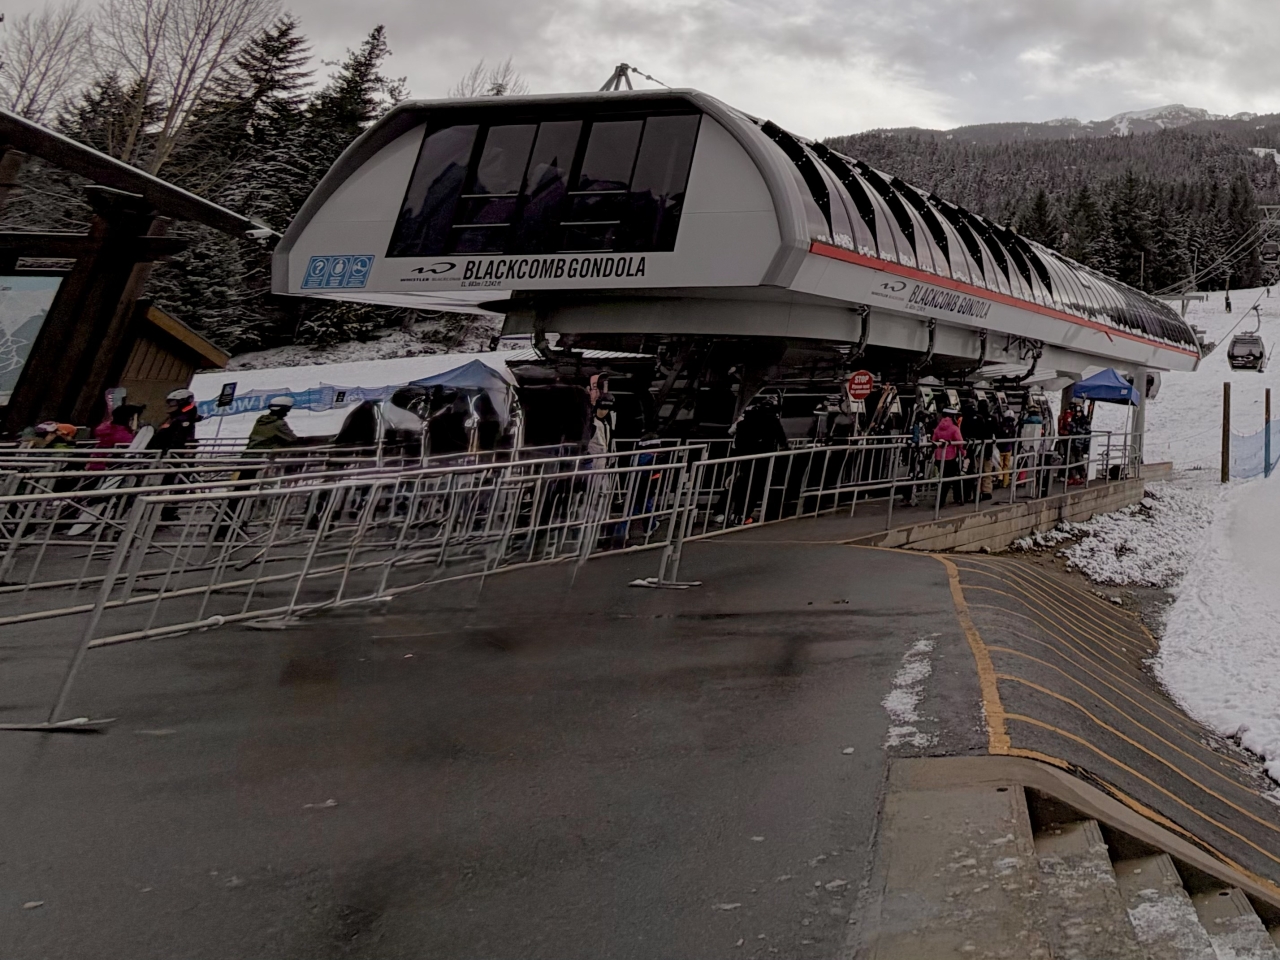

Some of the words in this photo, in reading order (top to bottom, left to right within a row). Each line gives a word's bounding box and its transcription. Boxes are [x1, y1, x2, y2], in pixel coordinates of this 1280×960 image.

[463, 258, 566, 280] BLACKCOMB
[567, 256, 646, 279] GONDOLA
[908, 284, 960, 312] BLACKCOMB
[957, 297, 992, 320] GONDOLA
[854, 375, 870, 384] STOP
